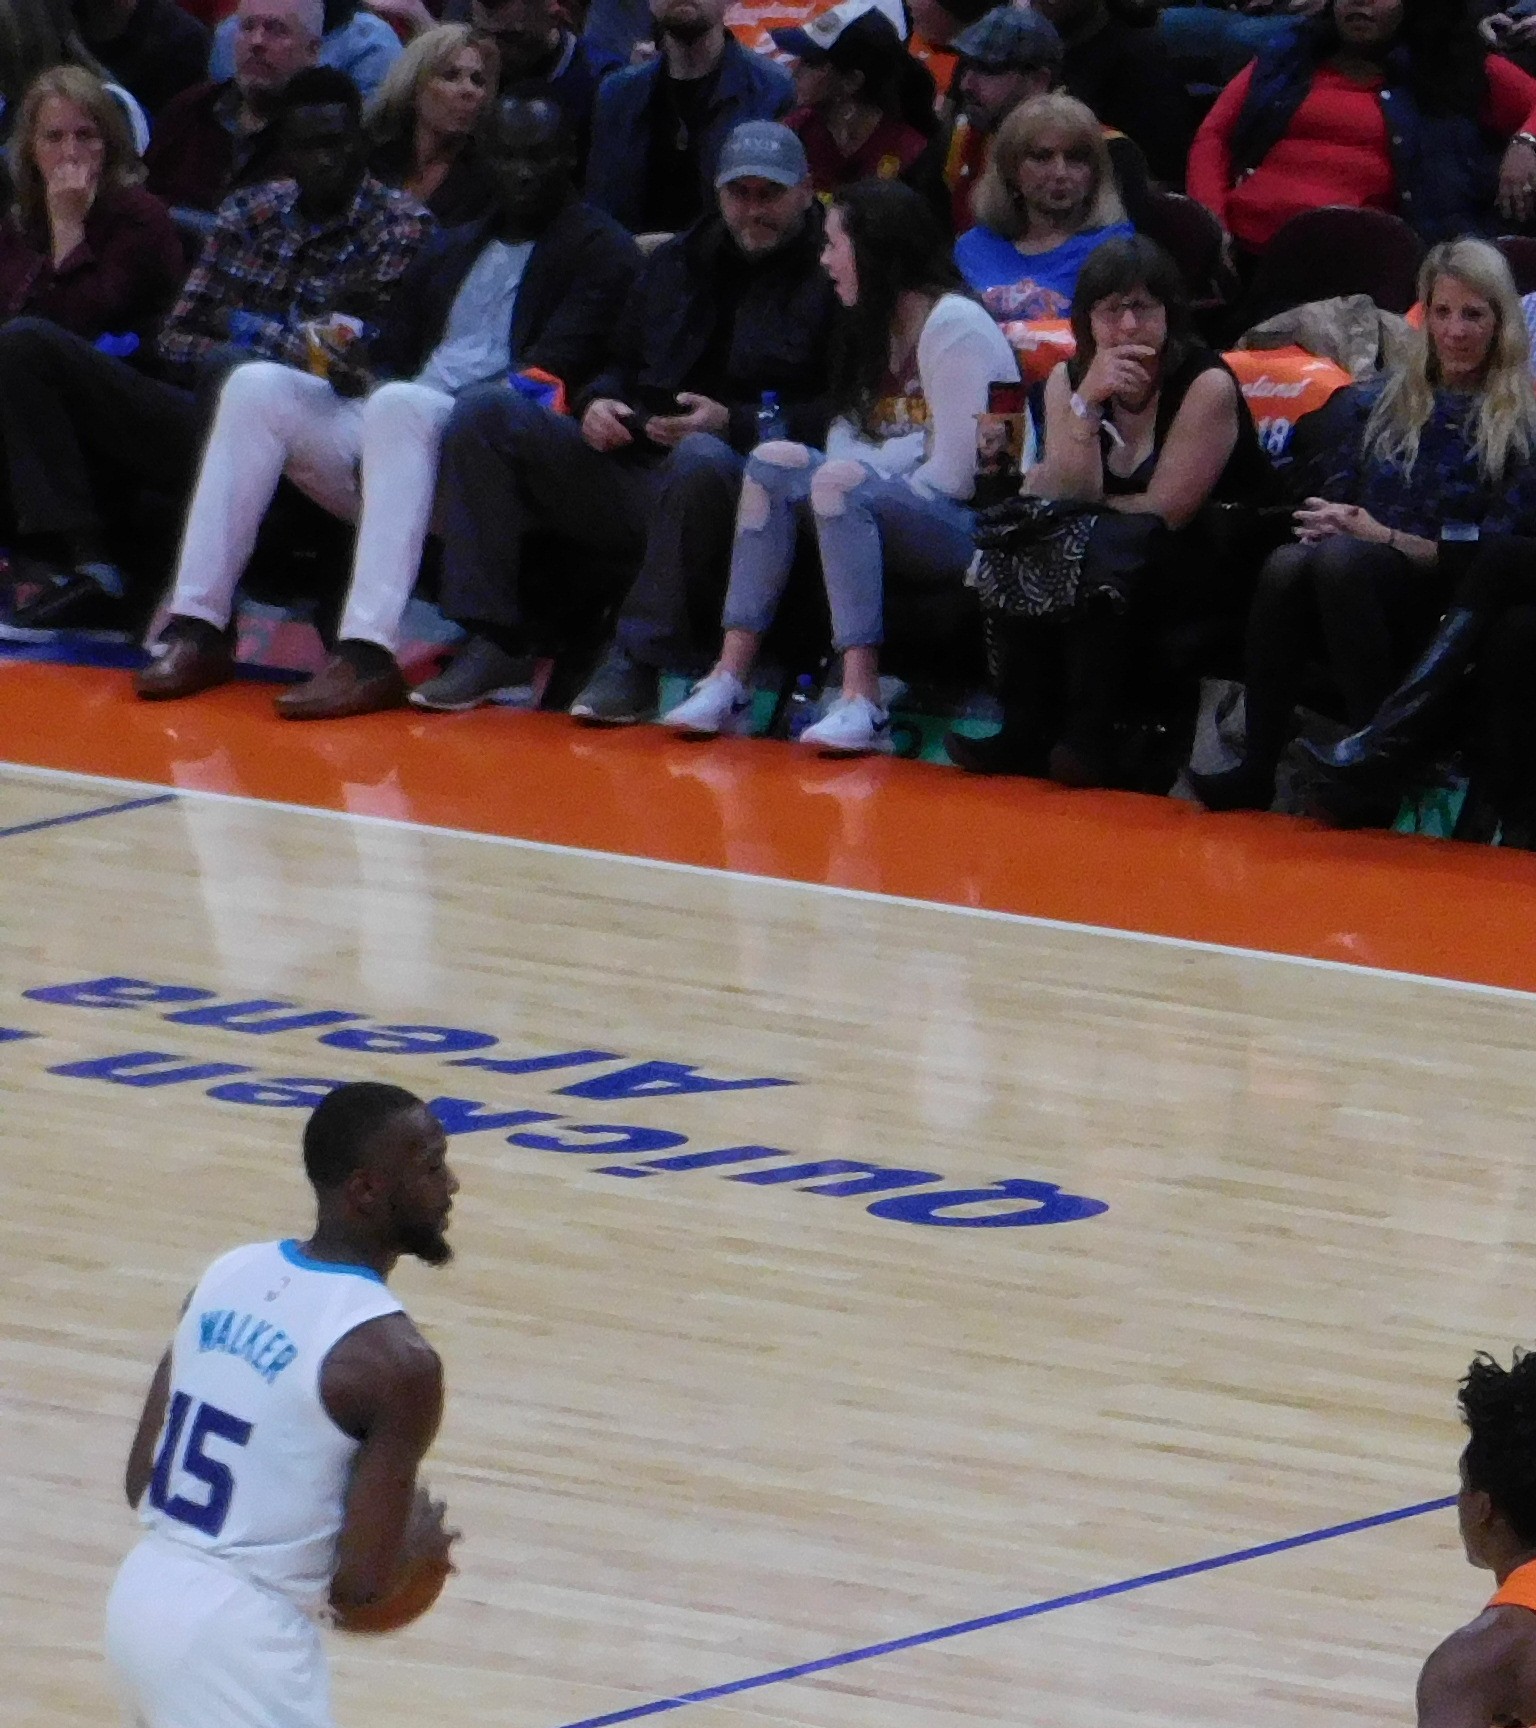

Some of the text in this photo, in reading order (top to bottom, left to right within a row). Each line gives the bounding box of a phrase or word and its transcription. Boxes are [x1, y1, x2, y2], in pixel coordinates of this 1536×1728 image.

[20, 976, 800, 1101] Arena
[198, 1308, 299, 1387] WALKER
[149, 1389, 255, 1538] 15
